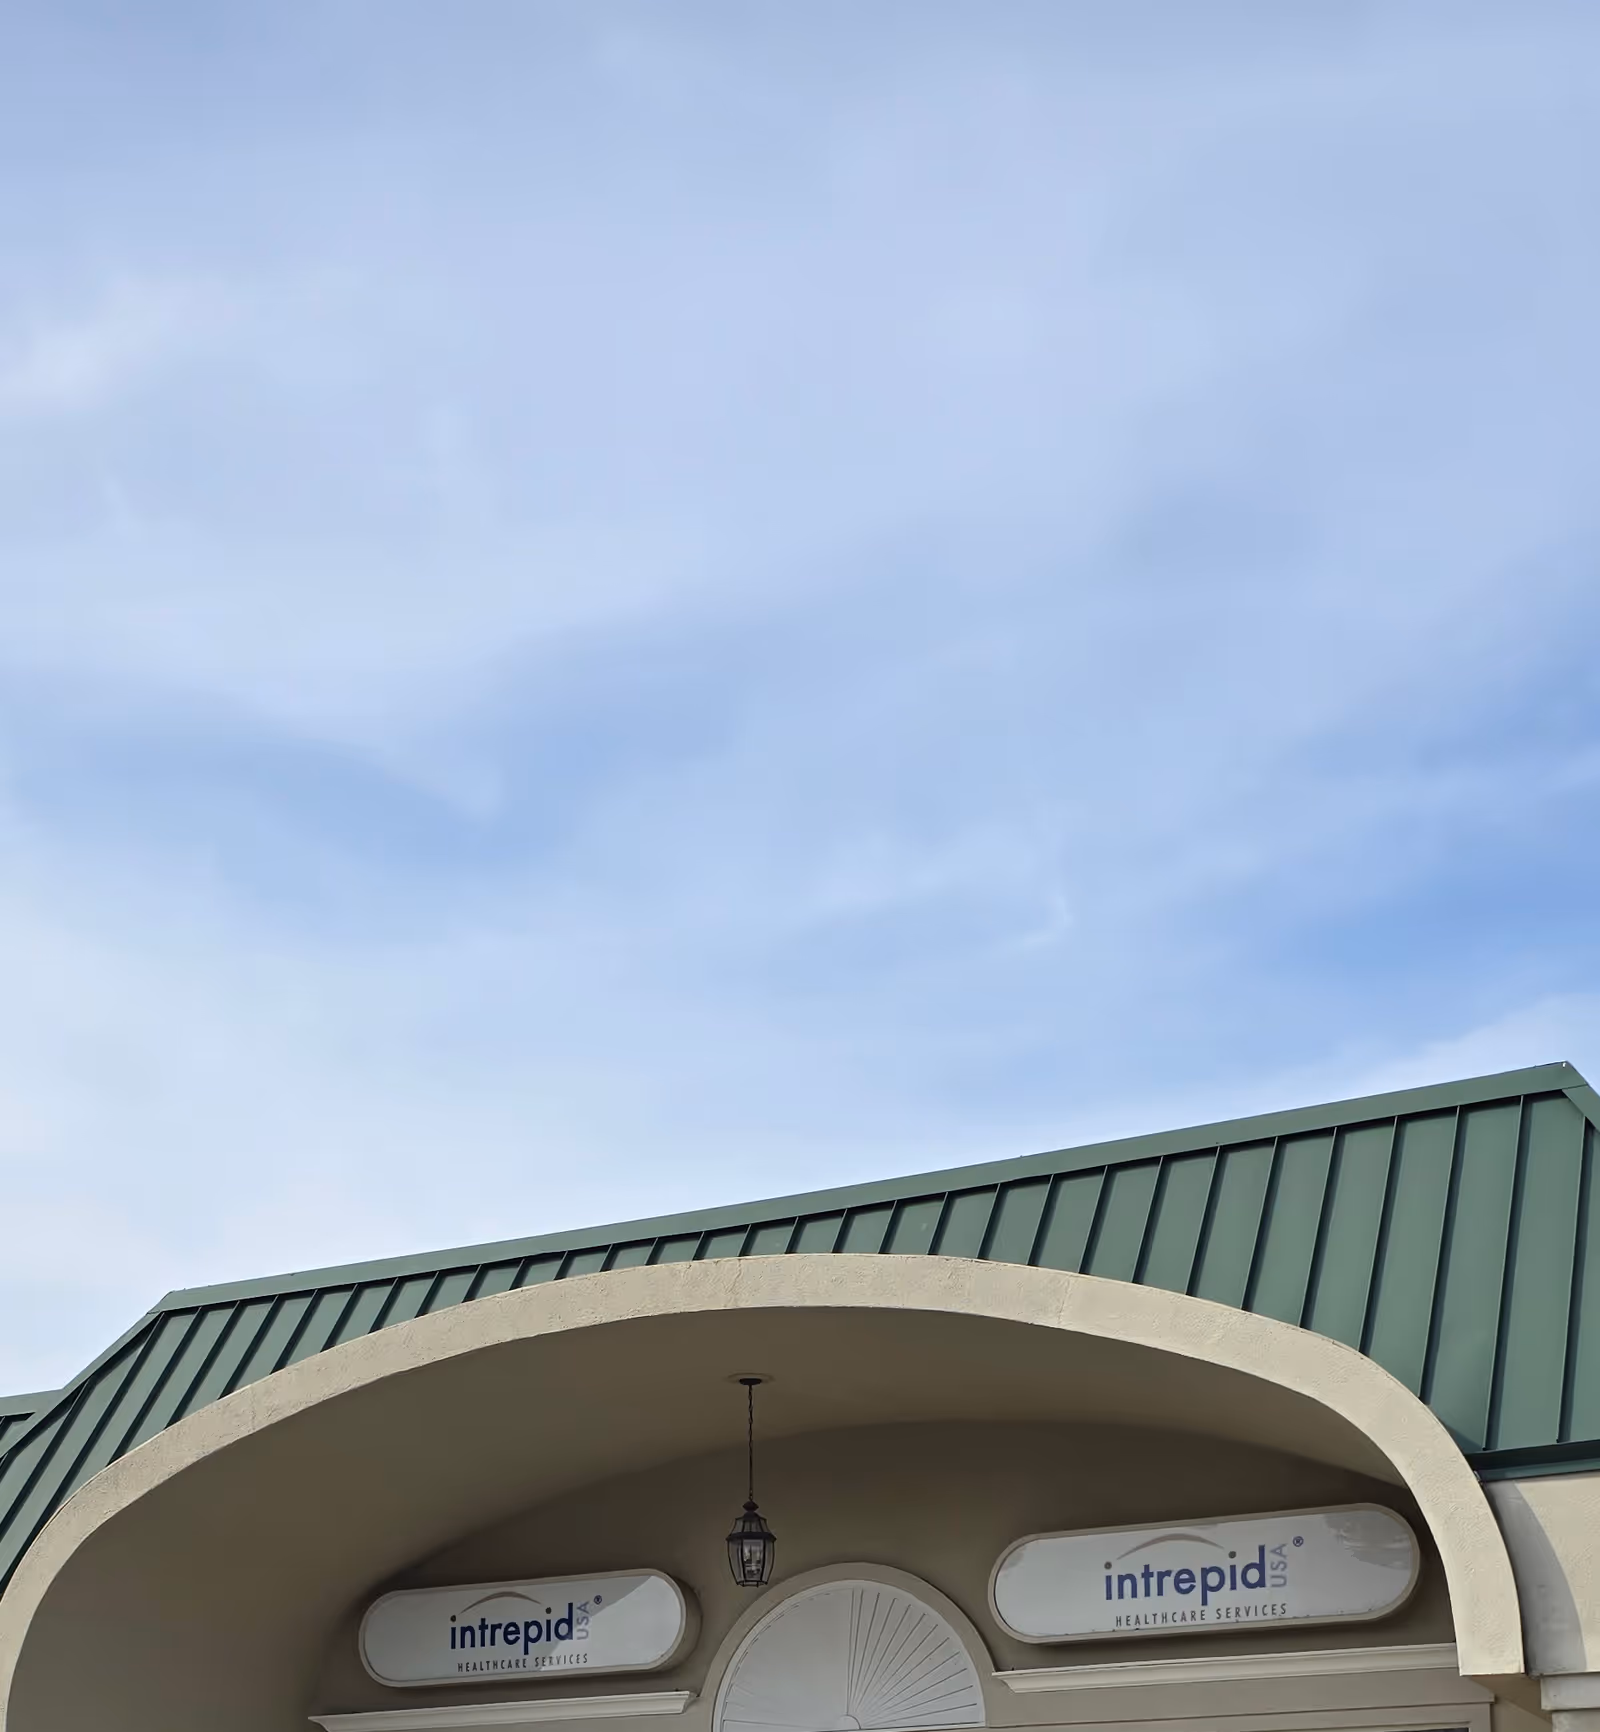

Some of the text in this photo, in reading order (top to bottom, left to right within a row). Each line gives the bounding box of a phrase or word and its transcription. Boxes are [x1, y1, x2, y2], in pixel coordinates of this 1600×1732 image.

[1104, 1544, 1266, 1606] intrepid
[1270, 1543, 1288, 1588] USA
[450, 1602, 574, 1655] intrepid
[576, 1601, 591, 1640] USA
[1115, 1603, 1288, 1627] HEALTHCARE SERVICES
[457, 1653, 588, 1672] HEALTHCARE SERVICES
